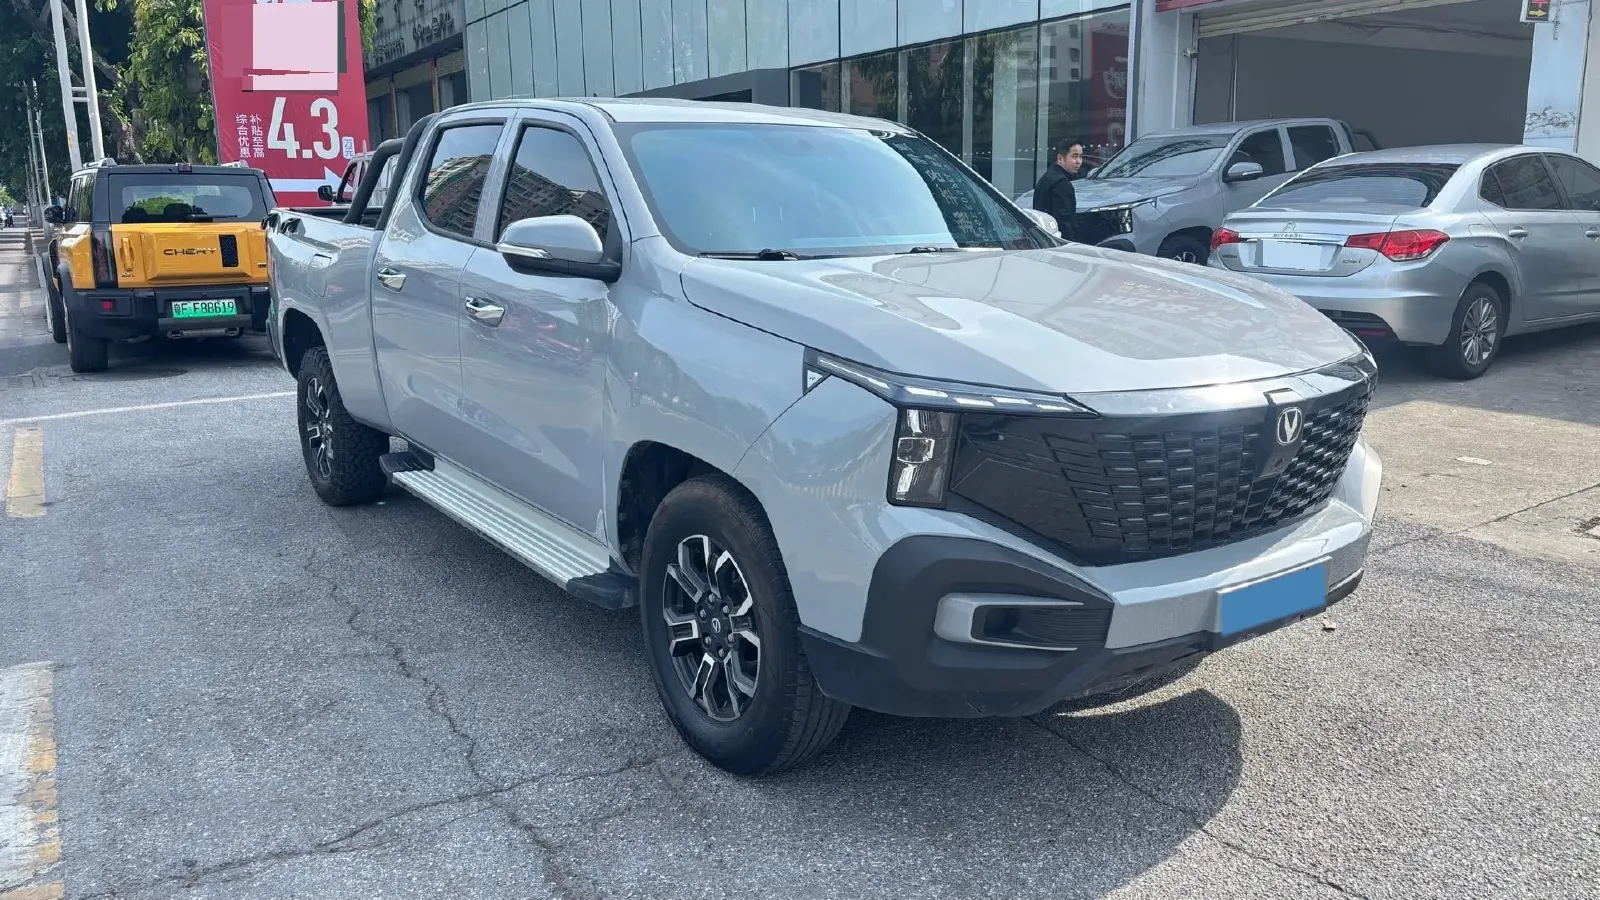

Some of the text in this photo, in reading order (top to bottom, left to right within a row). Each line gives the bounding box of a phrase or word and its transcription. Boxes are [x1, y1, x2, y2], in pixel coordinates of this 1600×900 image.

[235, 113, 251, 158] 综合优惠
[249, 113, 265, 158] 补贴至高
[267, 97, 340, 159] 4.3
[344, 137, 354, 157] 万元
[163, 247, 217, 256] CHERY
